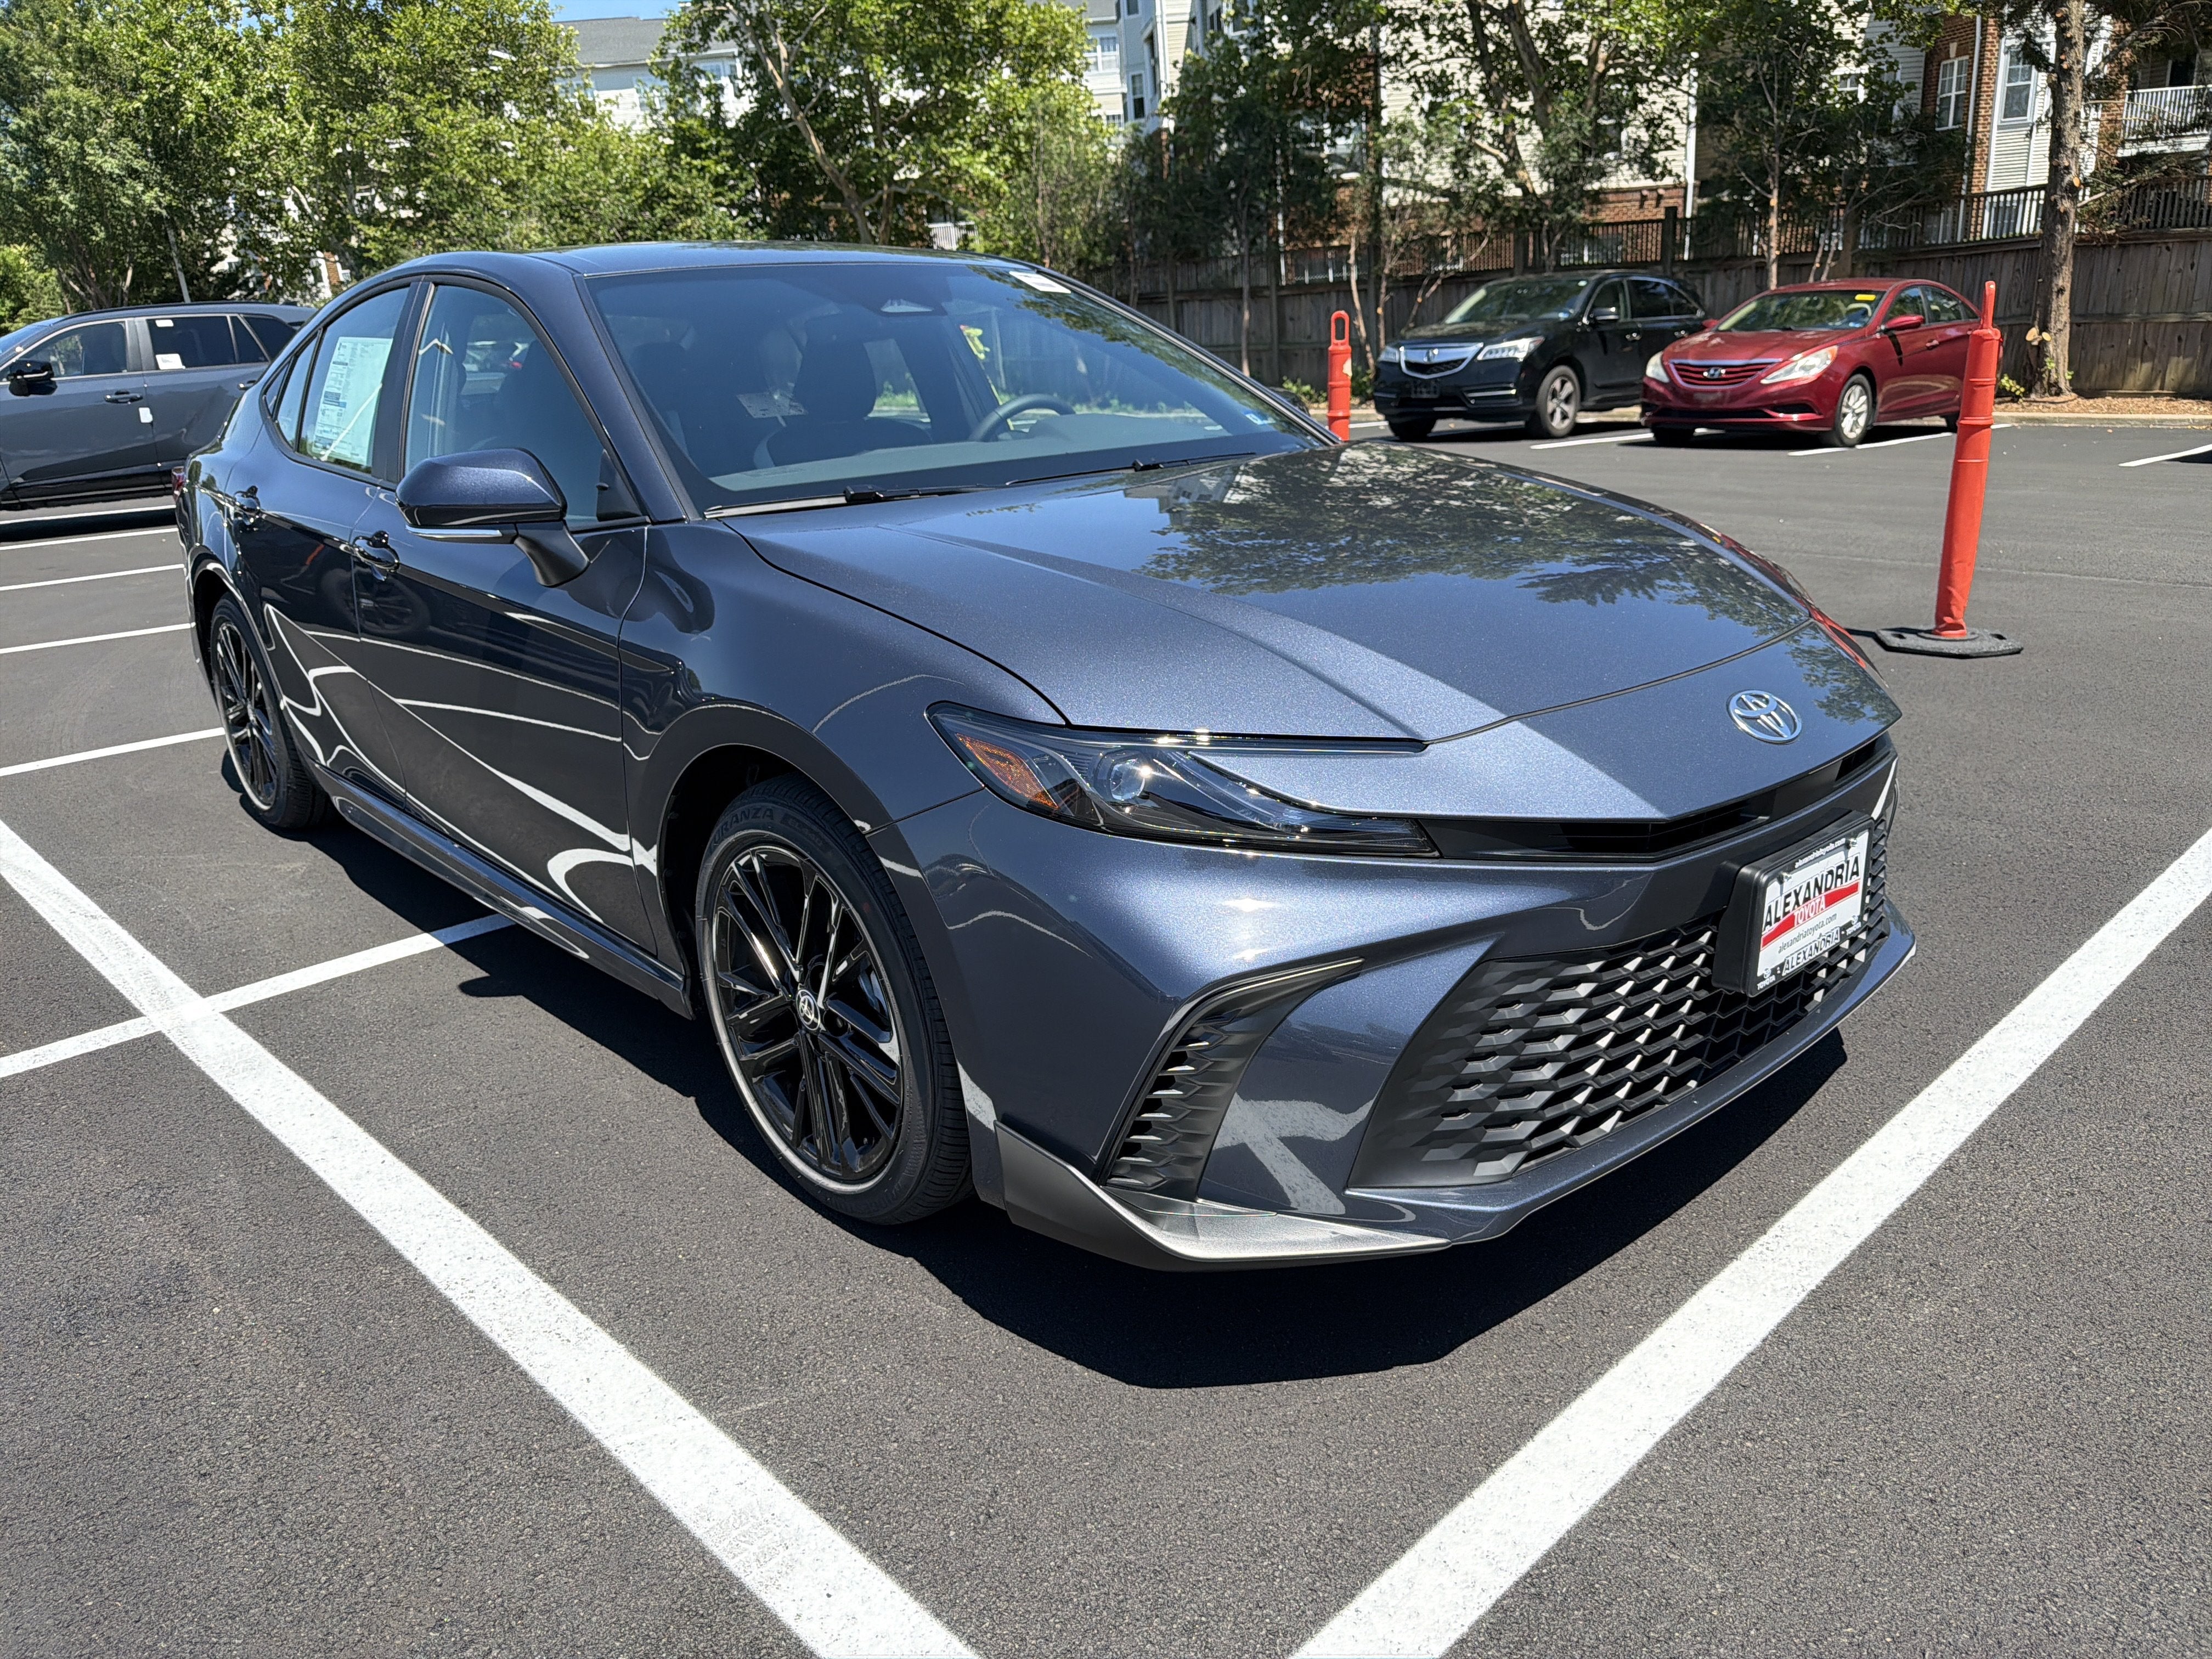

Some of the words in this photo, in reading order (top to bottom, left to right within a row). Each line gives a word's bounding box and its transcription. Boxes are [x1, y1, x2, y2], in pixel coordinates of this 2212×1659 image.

[710, 808, 774, 848] URANZA
[1763, 855, 1860, 930] ALEXANDRIA
[1794, 895, 1826, 927] TOYOTA
[1778, 913, 1837, 953] alexandriatoyota.com
[1782, 927, 1840, 975] ALEXANDRIA
[1757, 975, 1775, 990] TOYOTA
